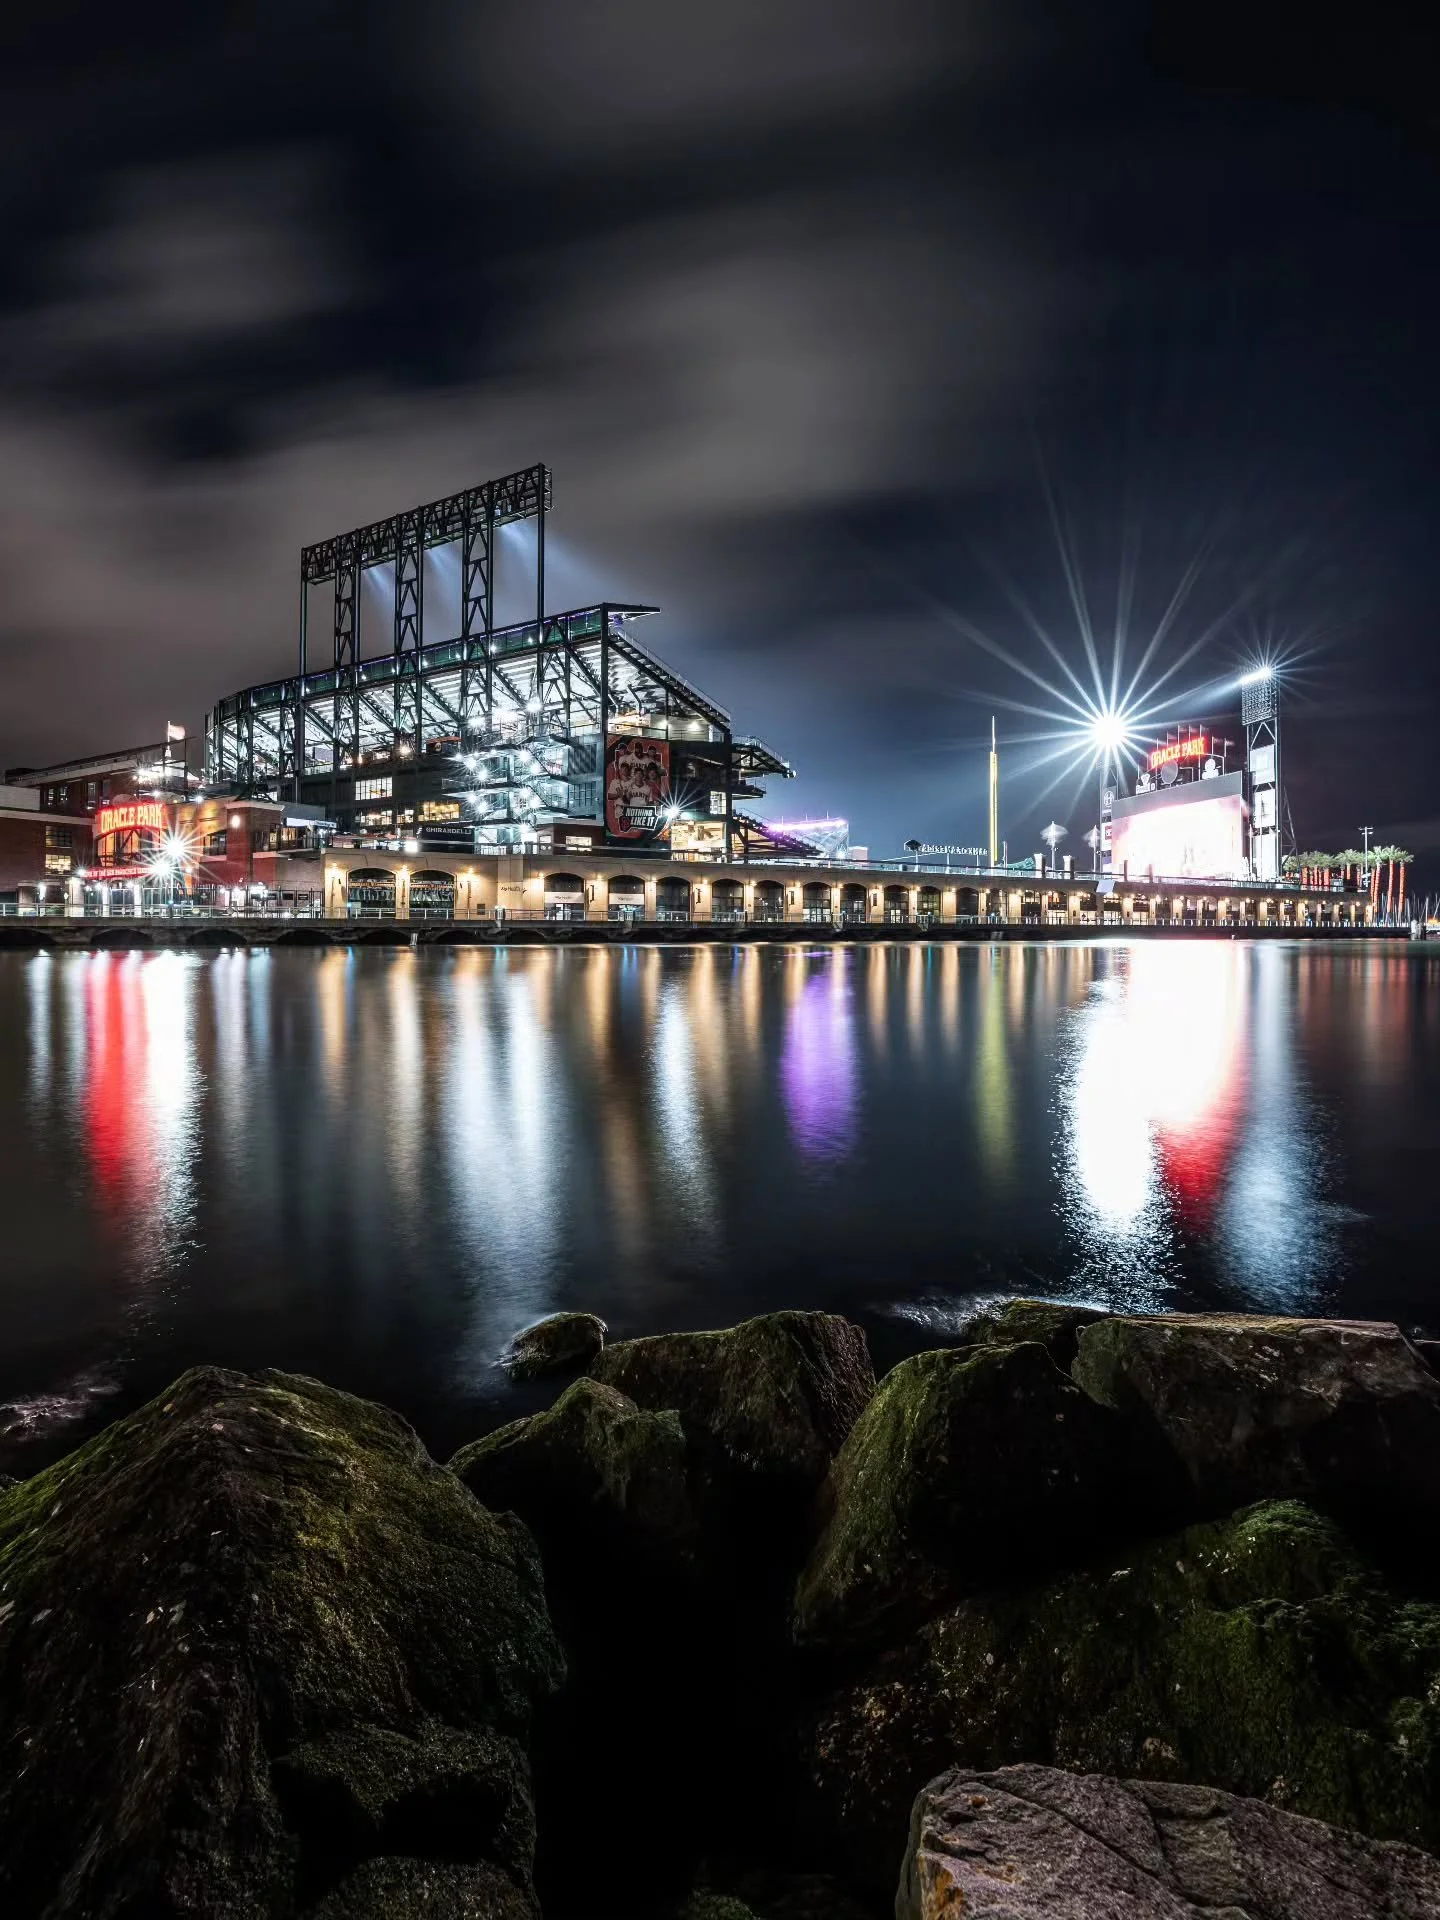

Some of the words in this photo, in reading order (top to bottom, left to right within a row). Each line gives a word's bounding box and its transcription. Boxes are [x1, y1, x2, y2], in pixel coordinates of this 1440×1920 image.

[1151, 746, 1180, 768] ORACLE
[1181, 738, 1205, 757] PARK
[101, 807, 136, 833] ORACLE
[137, 804, 163, 828] PARK
[625, 807, 653, 817] NOTHING
[630, 816, 646, 826] LIKE
[646, 816, 655, 827] IT
